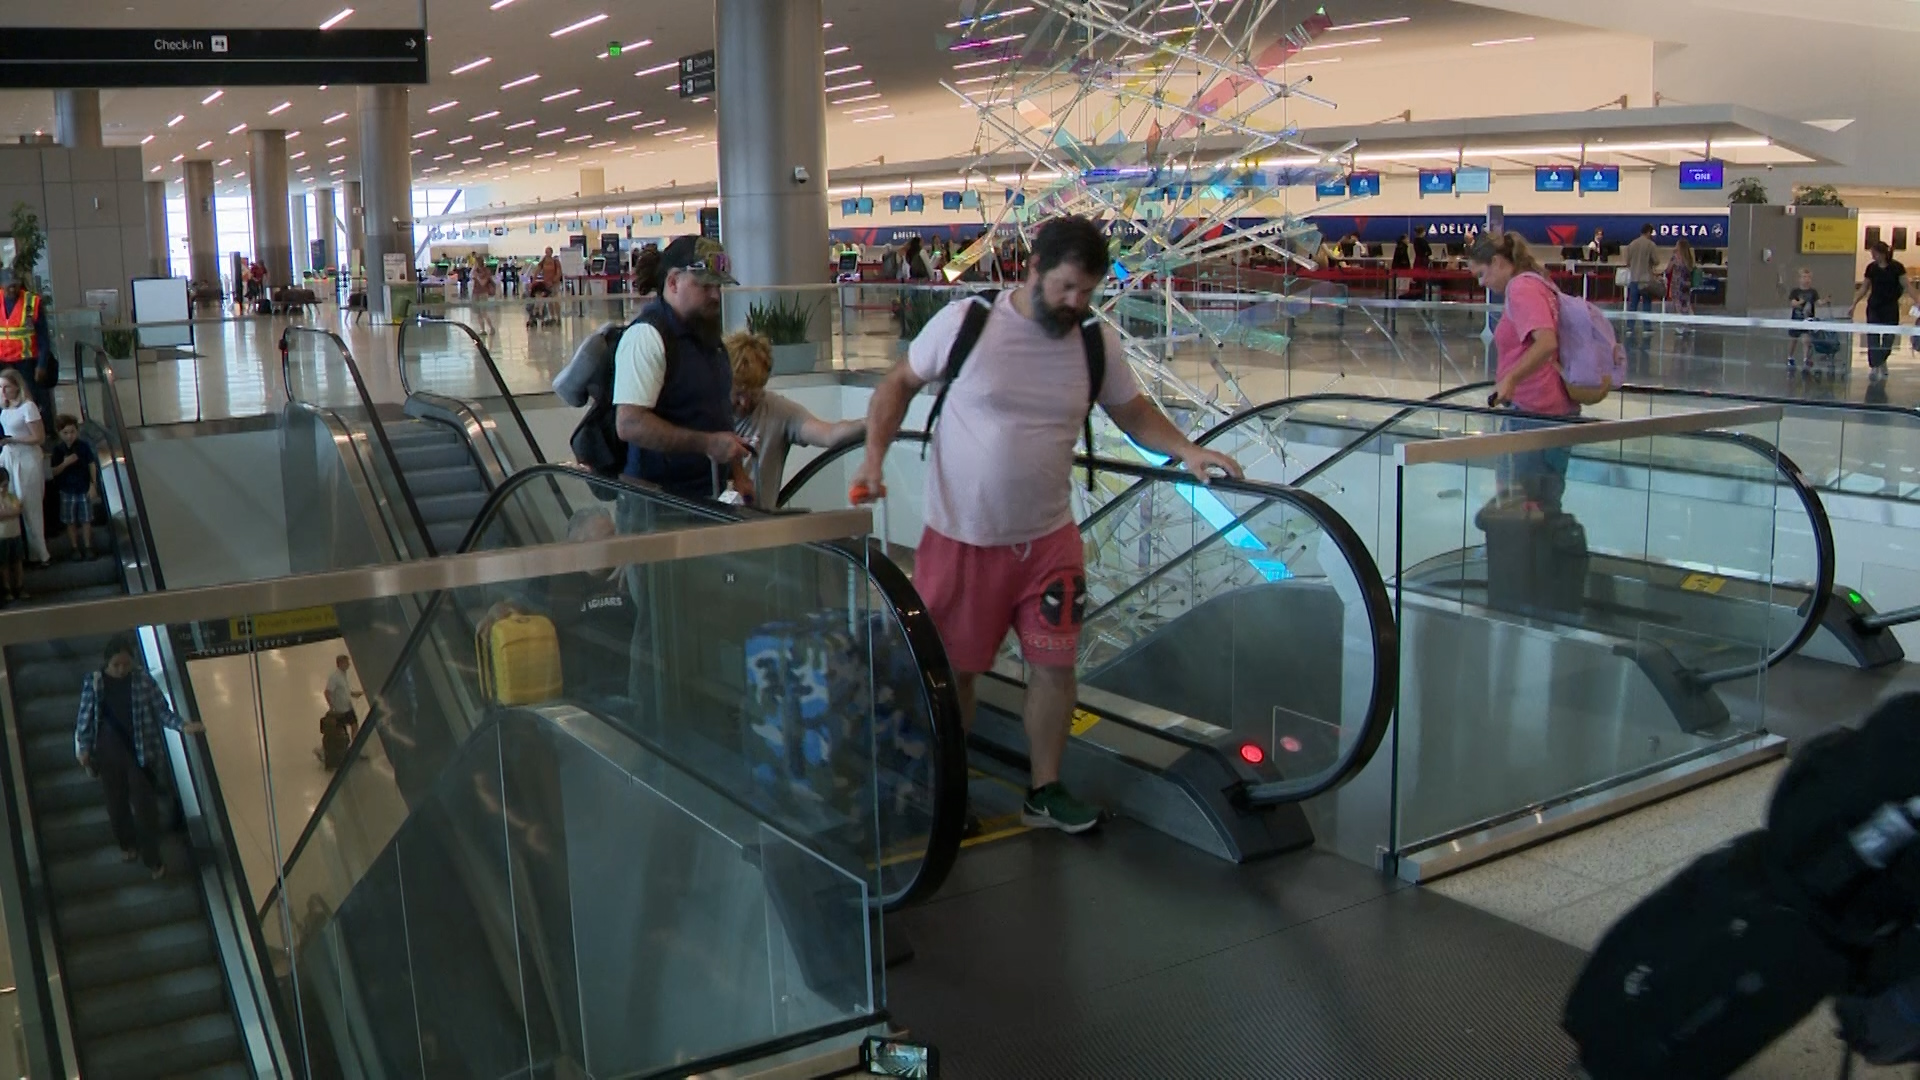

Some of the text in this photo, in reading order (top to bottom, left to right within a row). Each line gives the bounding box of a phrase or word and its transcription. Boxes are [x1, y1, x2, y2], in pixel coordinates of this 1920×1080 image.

[154, 39, 204, 50] Check-In
[1440, 223, 1479, 235] DELTA
[1660, 224, 1708, 236] DELTA
